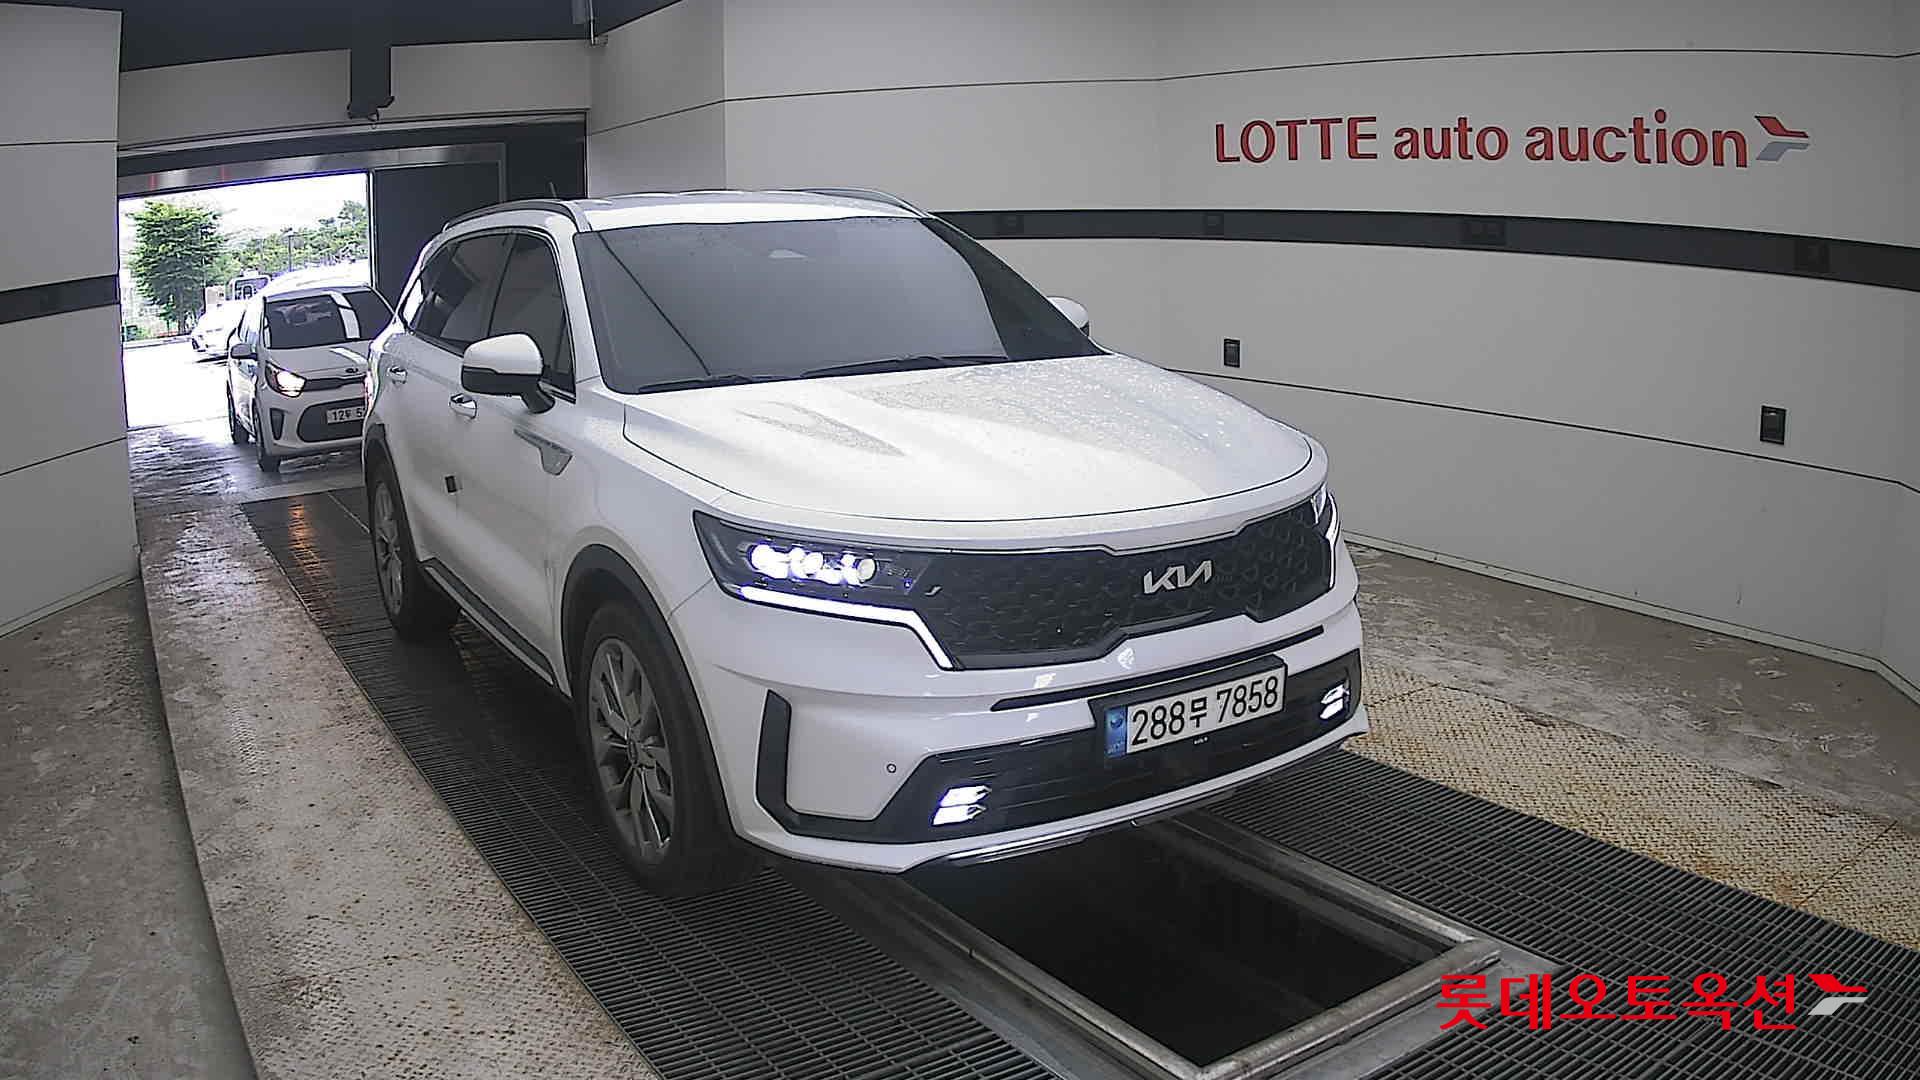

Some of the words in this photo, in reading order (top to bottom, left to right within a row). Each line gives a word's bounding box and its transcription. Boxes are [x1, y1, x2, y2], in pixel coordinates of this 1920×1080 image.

[1215, 116, 1378, 163] LOTTE
[1393, 116, 1508, 160] auto
[1524, 109, 1748, 168] auction
[1143, 560, 1212, 594] KIA
[1131, 696, 1208, 746] 288무
[1216, 675, 1279, 724] 7858
